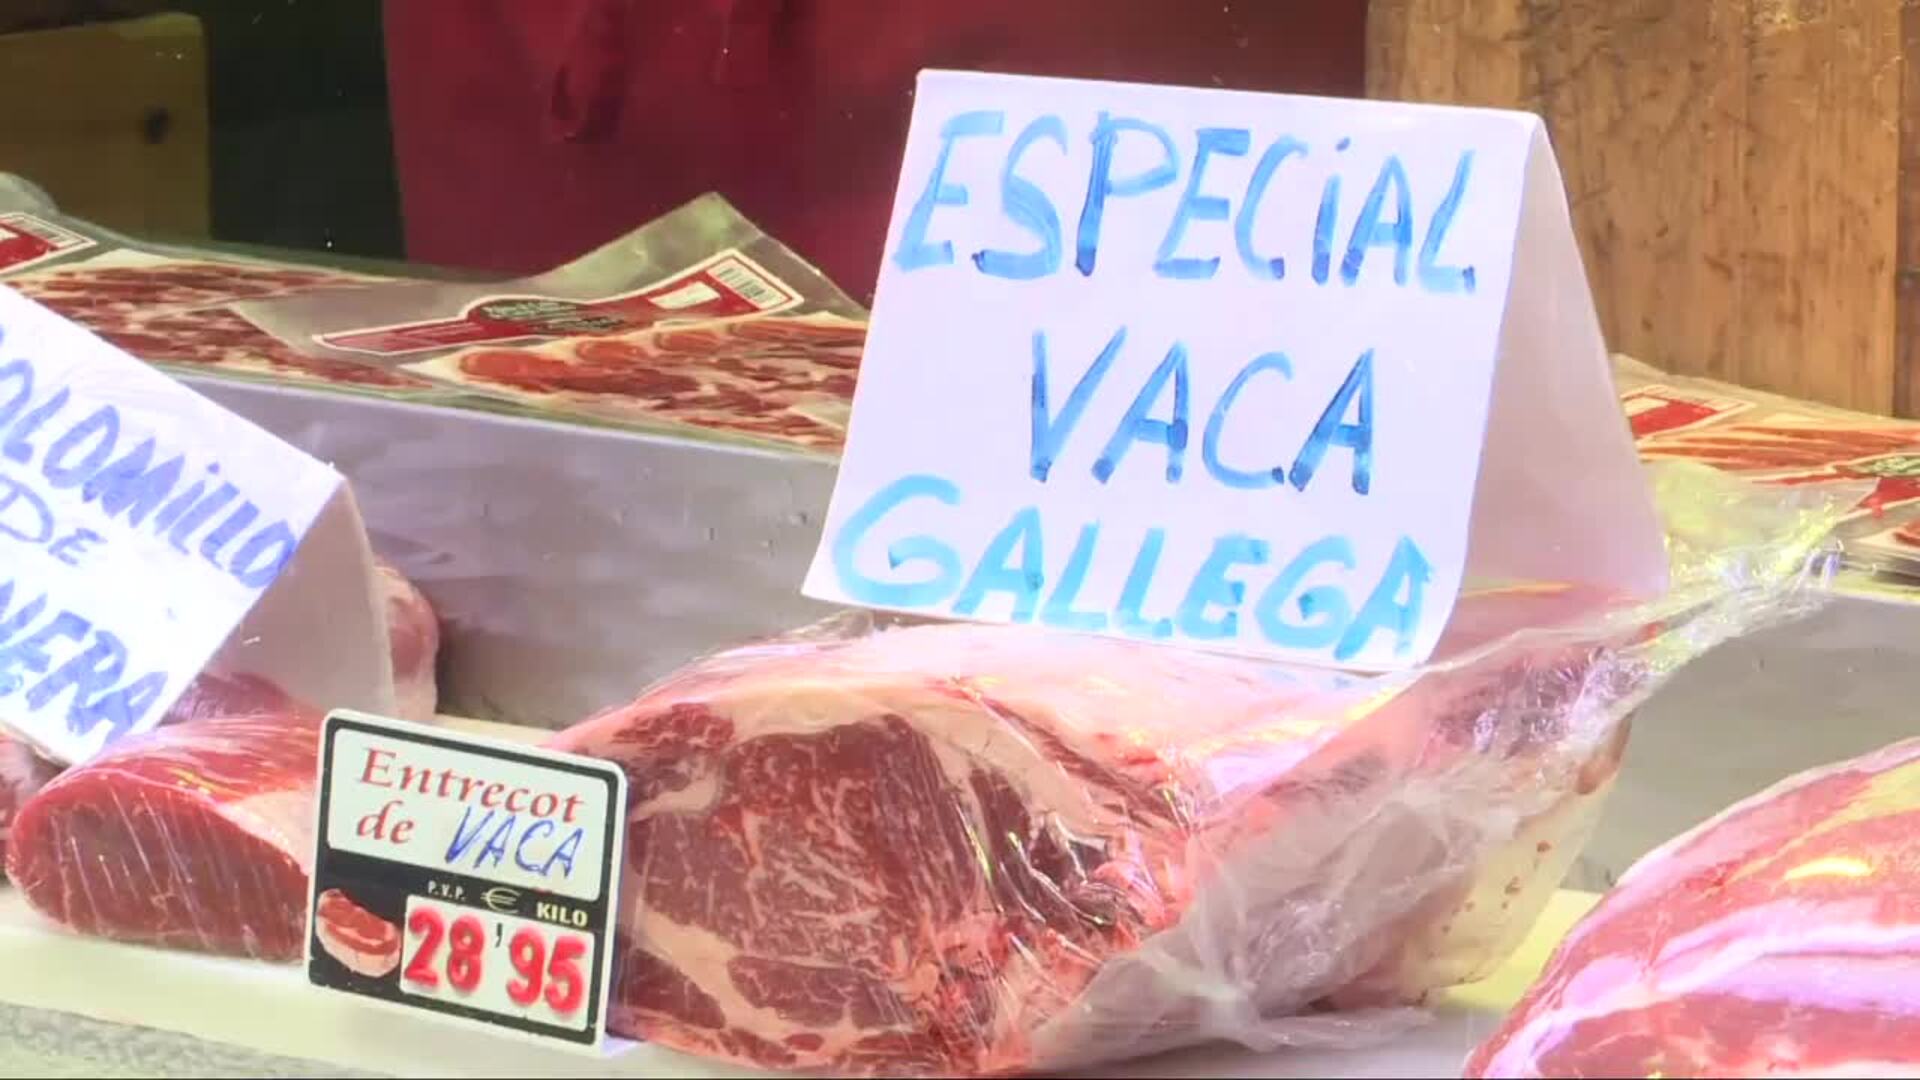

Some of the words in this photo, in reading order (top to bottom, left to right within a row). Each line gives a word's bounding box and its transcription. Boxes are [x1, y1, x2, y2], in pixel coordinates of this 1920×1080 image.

[1030, 326, 1374, 495] VACA
[0, 473, 108, 566] DE
[831, 474, 1433, 661] GALLEGA
[359, 747, 585, 822] Entrecot
[356, 800, 415, 844] de
[445, 805, 585, 880] VACA
[427, 880, 466, 900] P.V.P.
[536, 901, 588, 927] KILO
